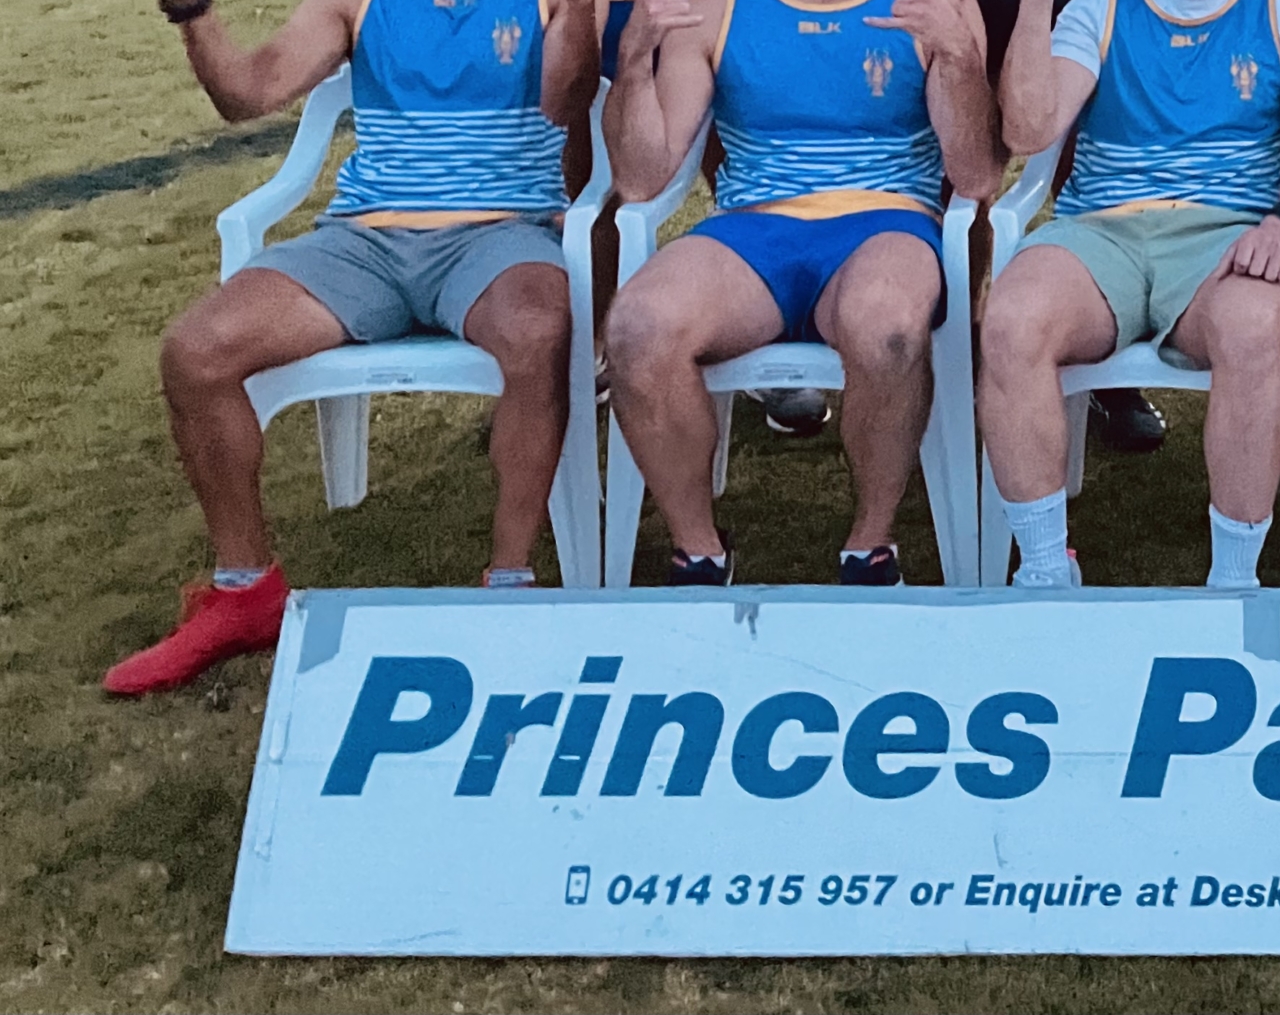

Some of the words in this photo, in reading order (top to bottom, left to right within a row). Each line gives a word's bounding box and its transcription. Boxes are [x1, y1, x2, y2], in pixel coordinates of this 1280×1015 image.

[319, 655, 1059, 800] Princes
[606, 873, 713, 907] 0414
[724, 873, 806, 907] 315
[816, 873, 899, 907] 957
[908, 880, 956, 907] or
[963, 872, 1123, 915] Enquire
[1134, 877, 1180, 909] at
